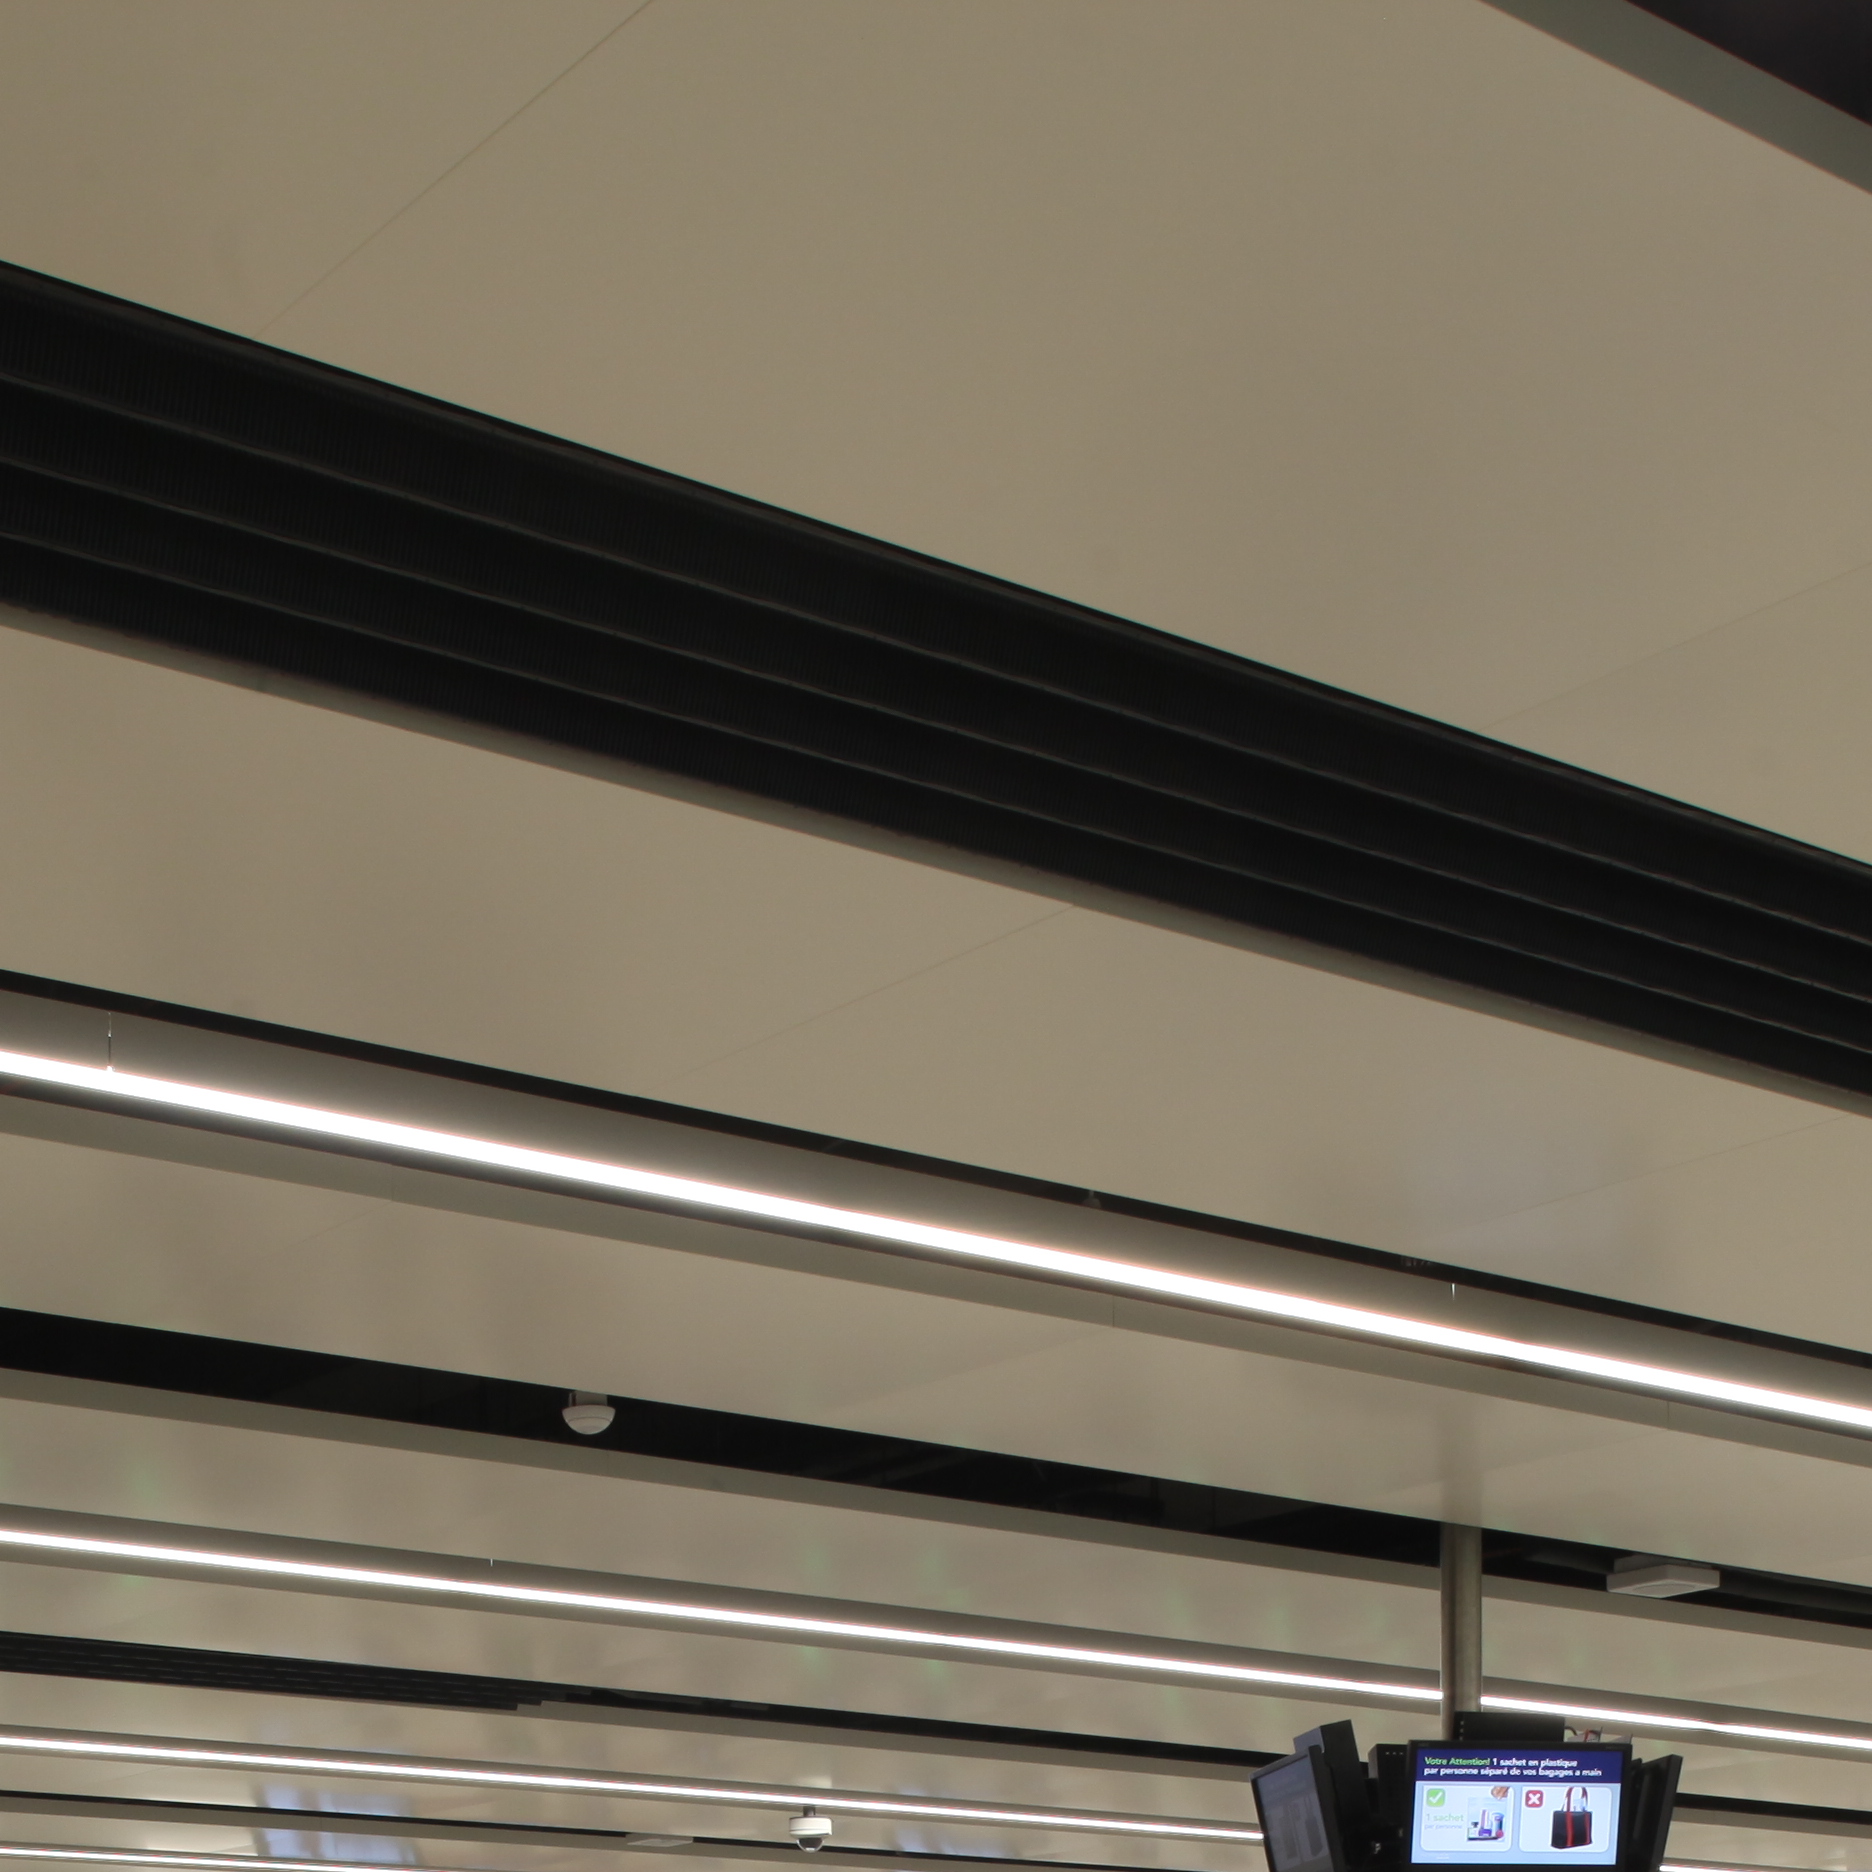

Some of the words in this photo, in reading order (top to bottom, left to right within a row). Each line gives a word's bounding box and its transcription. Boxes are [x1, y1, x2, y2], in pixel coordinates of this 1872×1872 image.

[1425, 1757, 1447, 1765] Votre
[1449, 1757, 1490, 1765] Attention!
[1500, 1758, 1526, 1766] sachet
[1541, 1759, 1577, 1768] plastique
[1424, 1768, 1438, 1776] par
[1440, 1768, 1478, 1776] personne
[1539, 1768, 1573, 1777] bagages
[1427, 1813, 1430, 1822] 1
[1433, 1813, 1464, 1822] sachet
